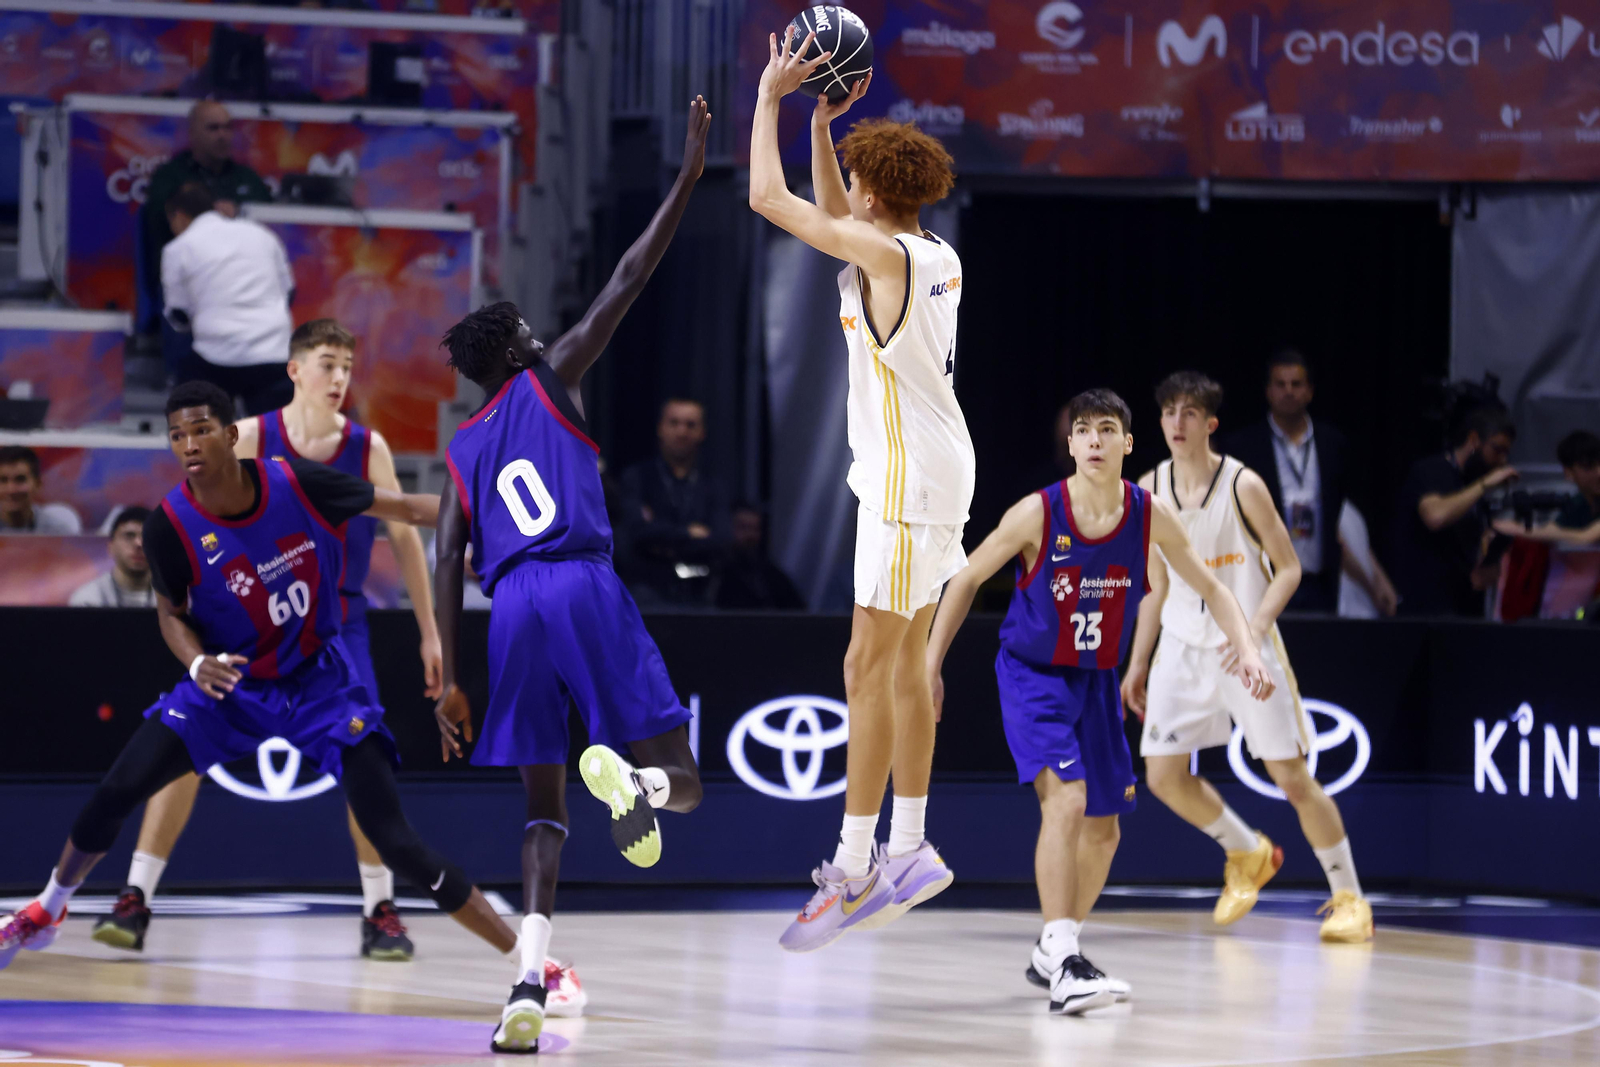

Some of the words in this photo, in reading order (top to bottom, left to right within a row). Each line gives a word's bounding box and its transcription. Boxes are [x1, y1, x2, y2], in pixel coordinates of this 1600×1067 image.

[1284, 20, 1480, 66] endesa
[497, 458, 556, 537] 0
[256, 540, 316, 575] Assistència
[268, 580, 311, 627] 60
[1079, 577, 1132, 590] Assistència
[1069, 612, 1104, 651] 23
